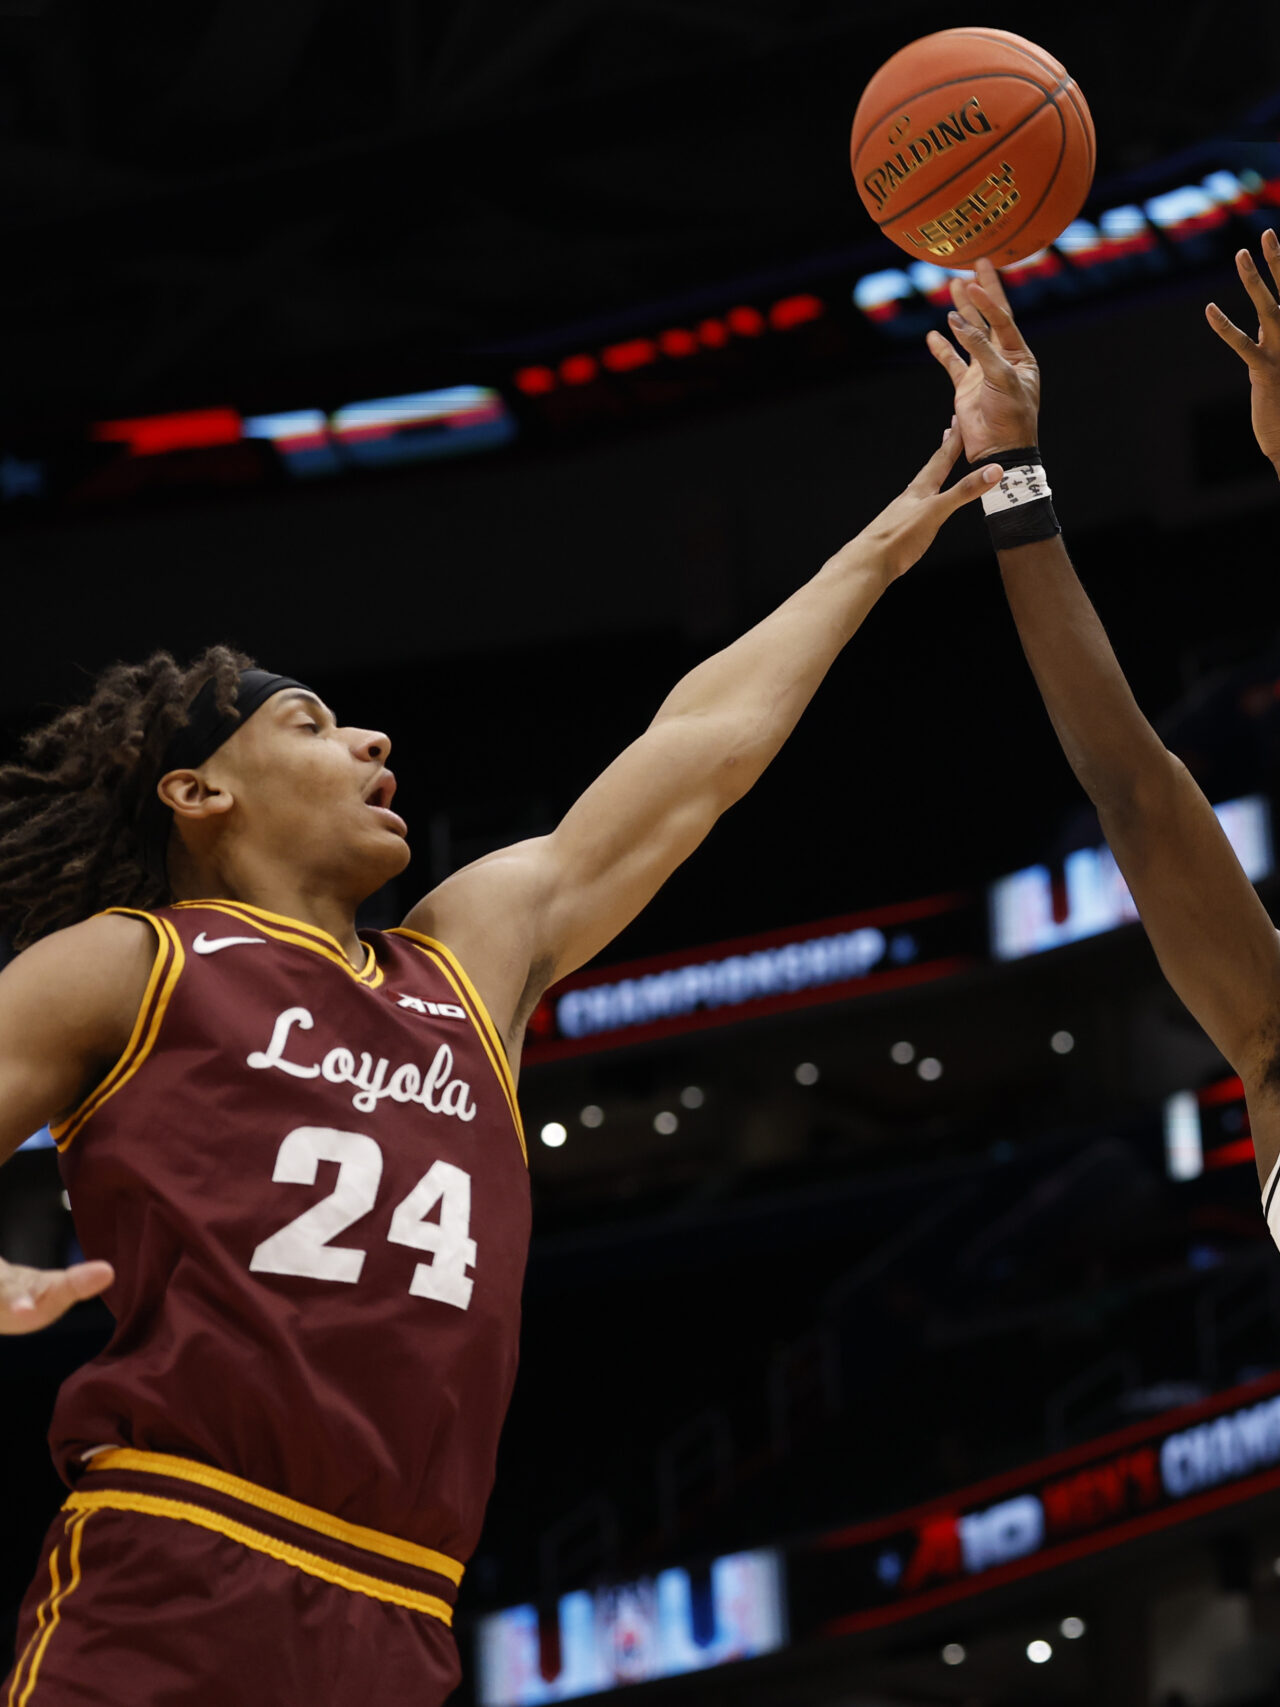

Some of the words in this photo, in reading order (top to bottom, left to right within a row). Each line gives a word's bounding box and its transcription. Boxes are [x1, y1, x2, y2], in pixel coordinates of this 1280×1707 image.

[864, 96, 992, 212] SPALDING
[903, 161, 1017, 247] LEGACY
[396, 993, 467, 1019] A10
[246, 1007, 477, 1122] Loyola
[249, 1125, 478, 1311] 24
[903, 1494, 1045, 1588] A10
